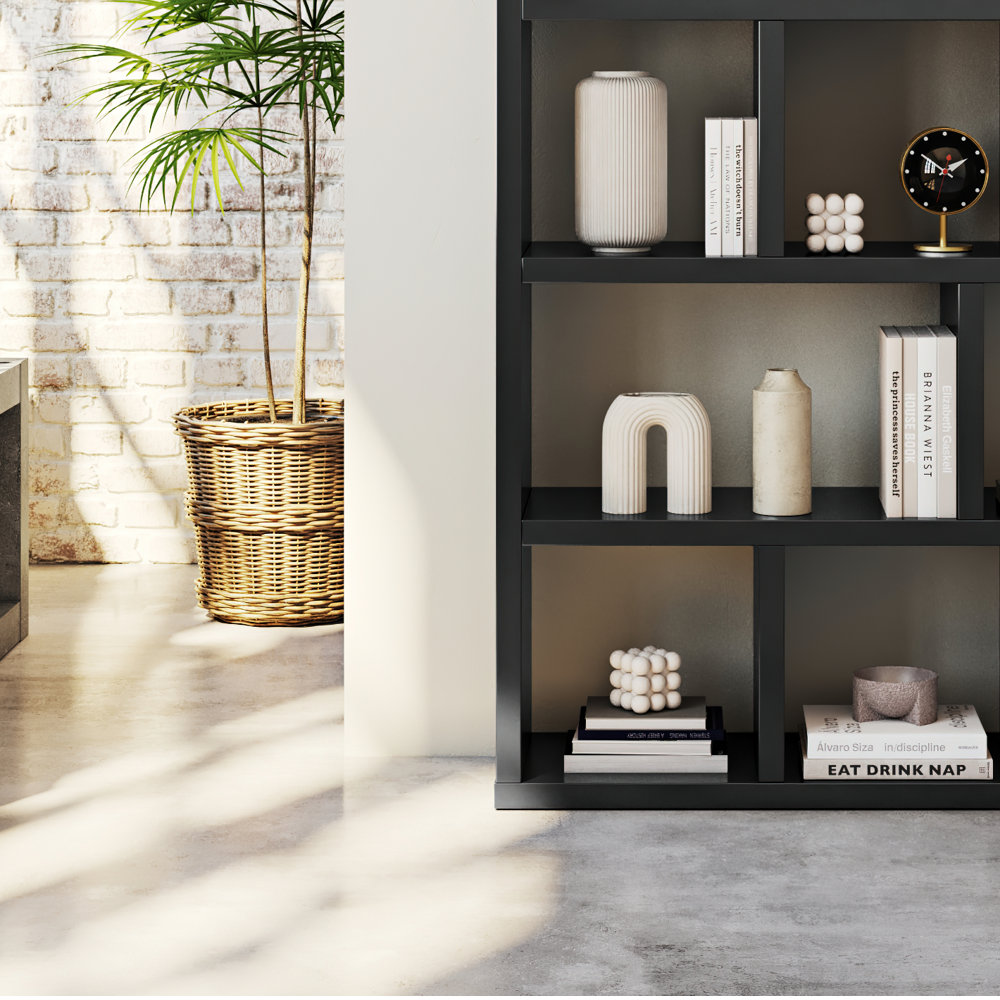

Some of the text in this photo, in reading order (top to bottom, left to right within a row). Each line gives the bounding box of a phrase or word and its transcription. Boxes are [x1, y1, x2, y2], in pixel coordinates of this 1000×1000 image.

[735, 217, 743, 237] burn
[904, 392, 916, 464] HOUSE BOOK
[923, 372, 933, 479] BRIANNA WIEST
[941, 385, 953, 474] Elizabeth Gaskell
[816, 741, 850, 752] Álvaro
[852, 743, 874, 752] Siza
[828, 764, 967, 776] EAT DRINK NAP
